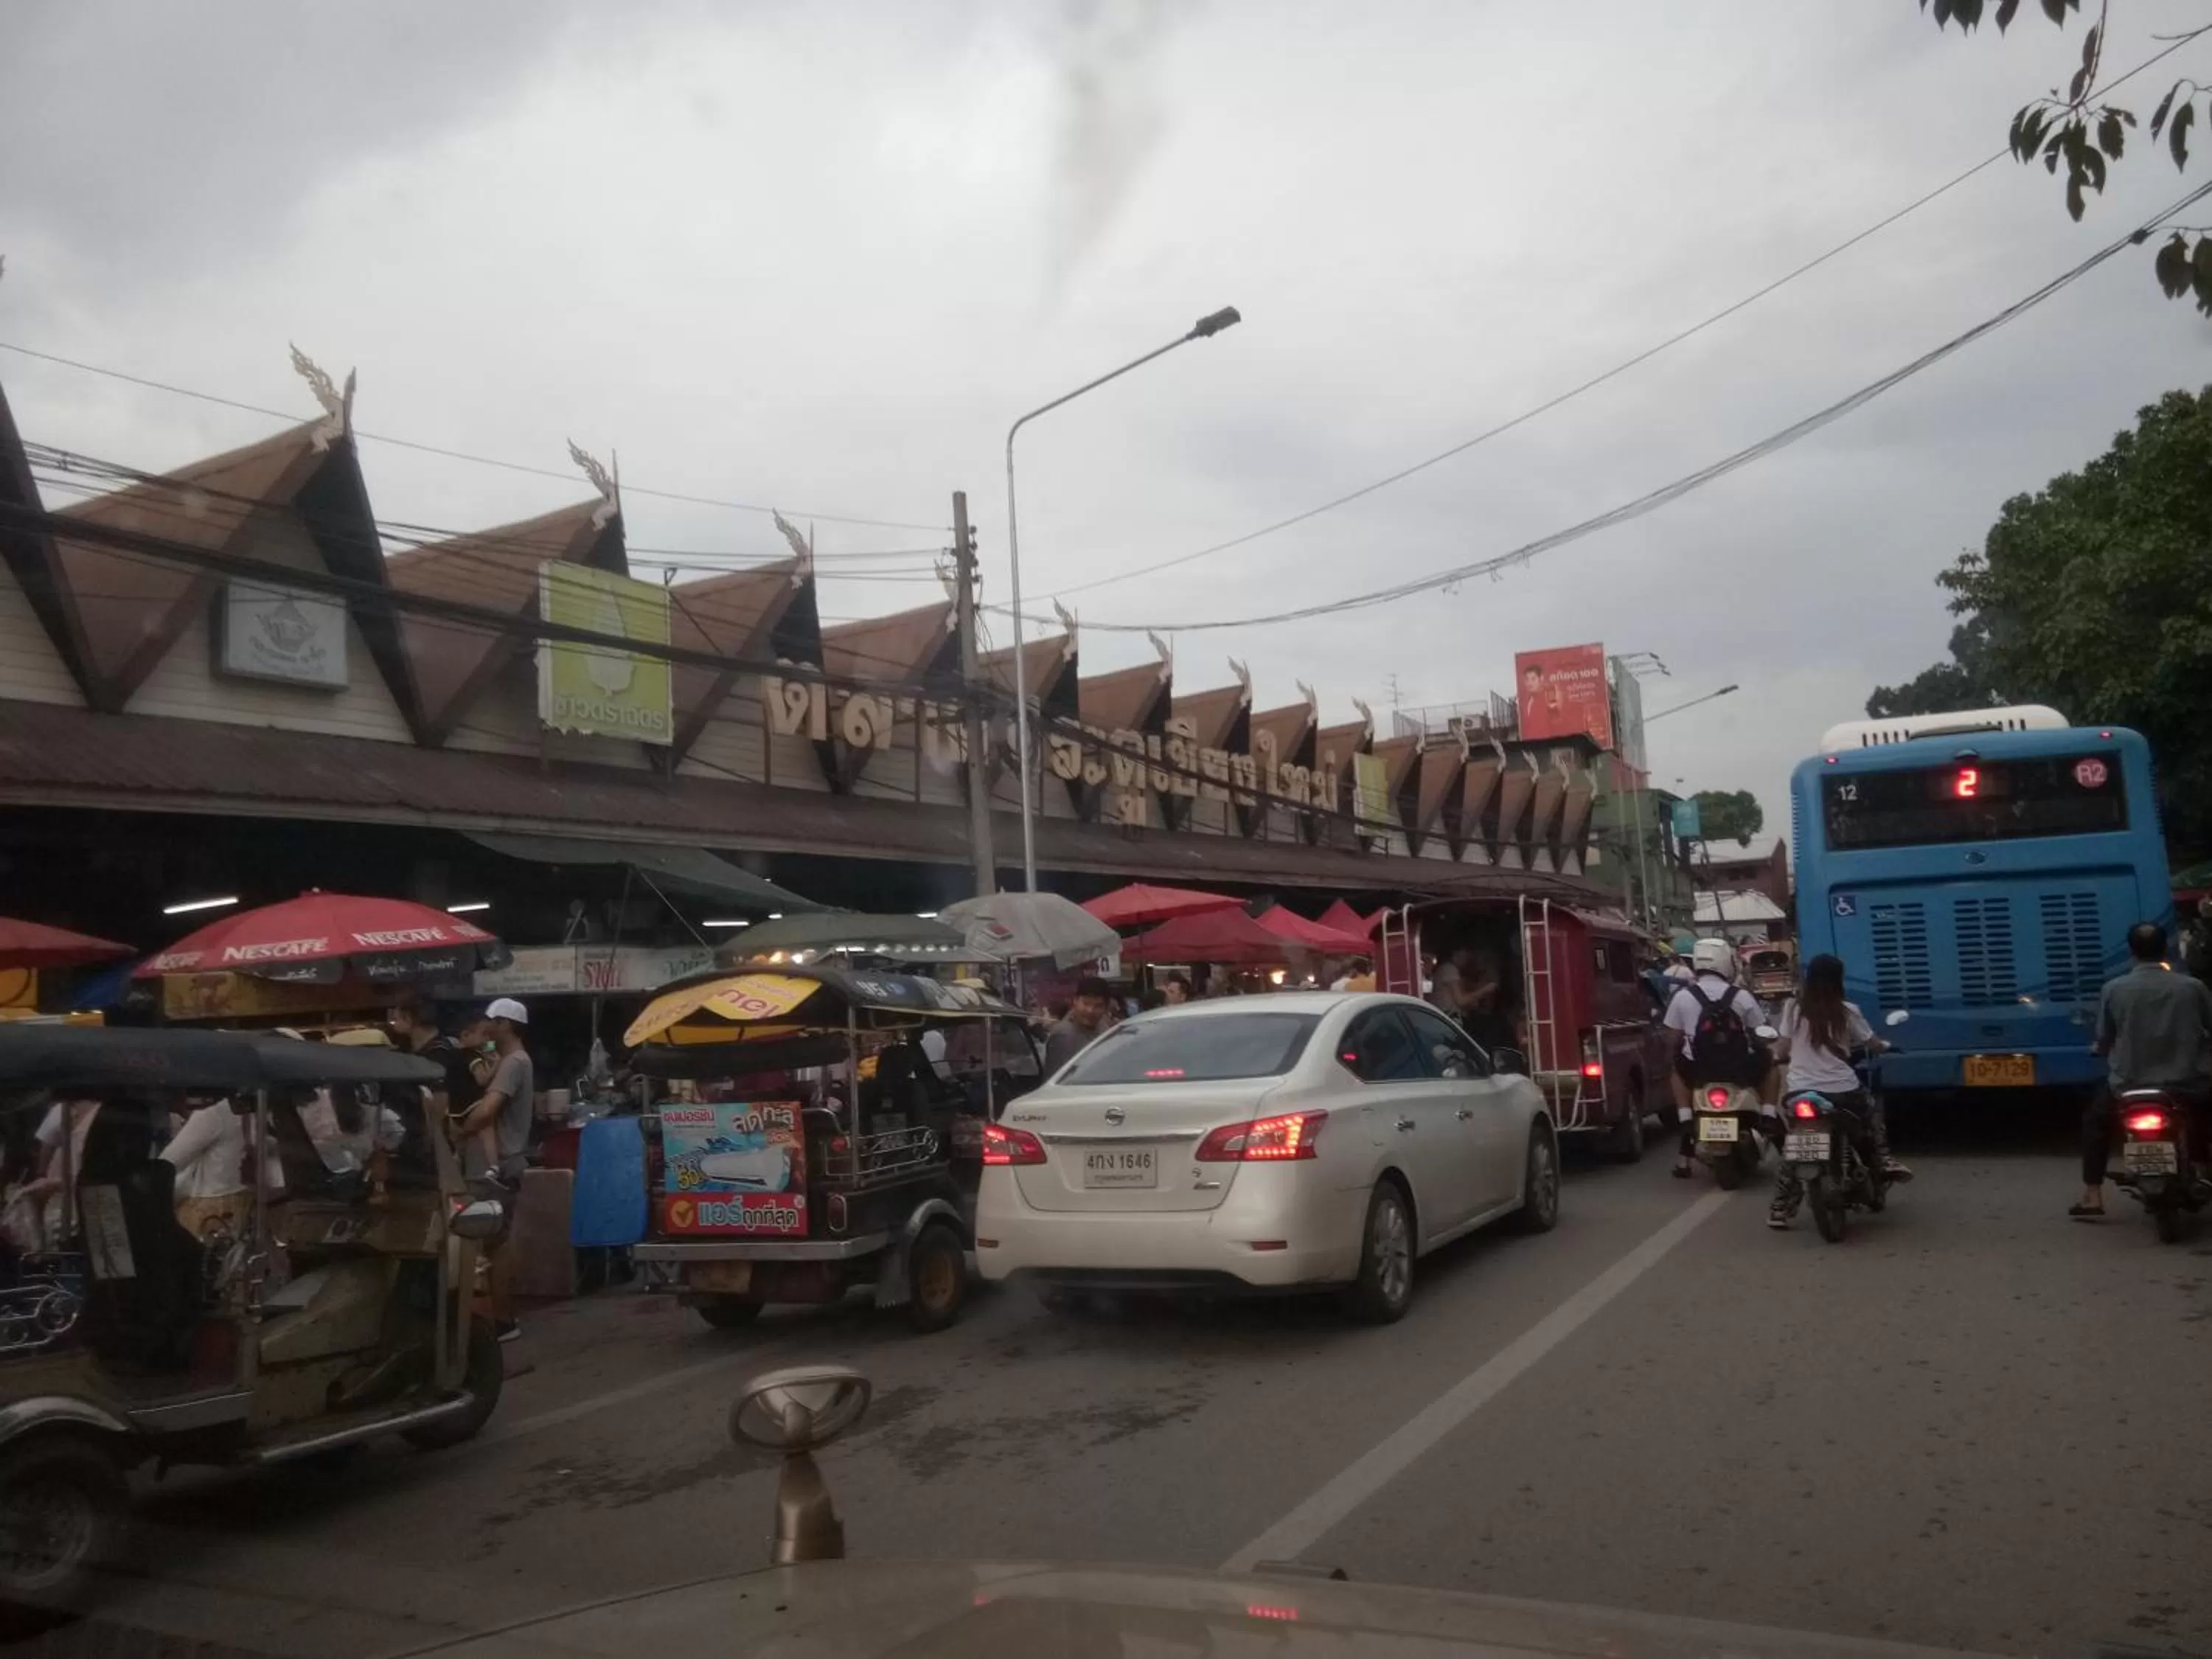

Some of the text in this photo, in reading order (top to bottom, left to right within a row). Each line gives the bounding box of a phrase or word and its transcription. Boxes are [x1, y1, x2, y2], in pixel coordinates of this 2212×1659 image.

[2075, 763, 2107, 783] R2
[1955, 768, 1978, 797] 2
[1837, 784, 1859, 801] 12
[1119, 1152, 1151, 1169] 1646
